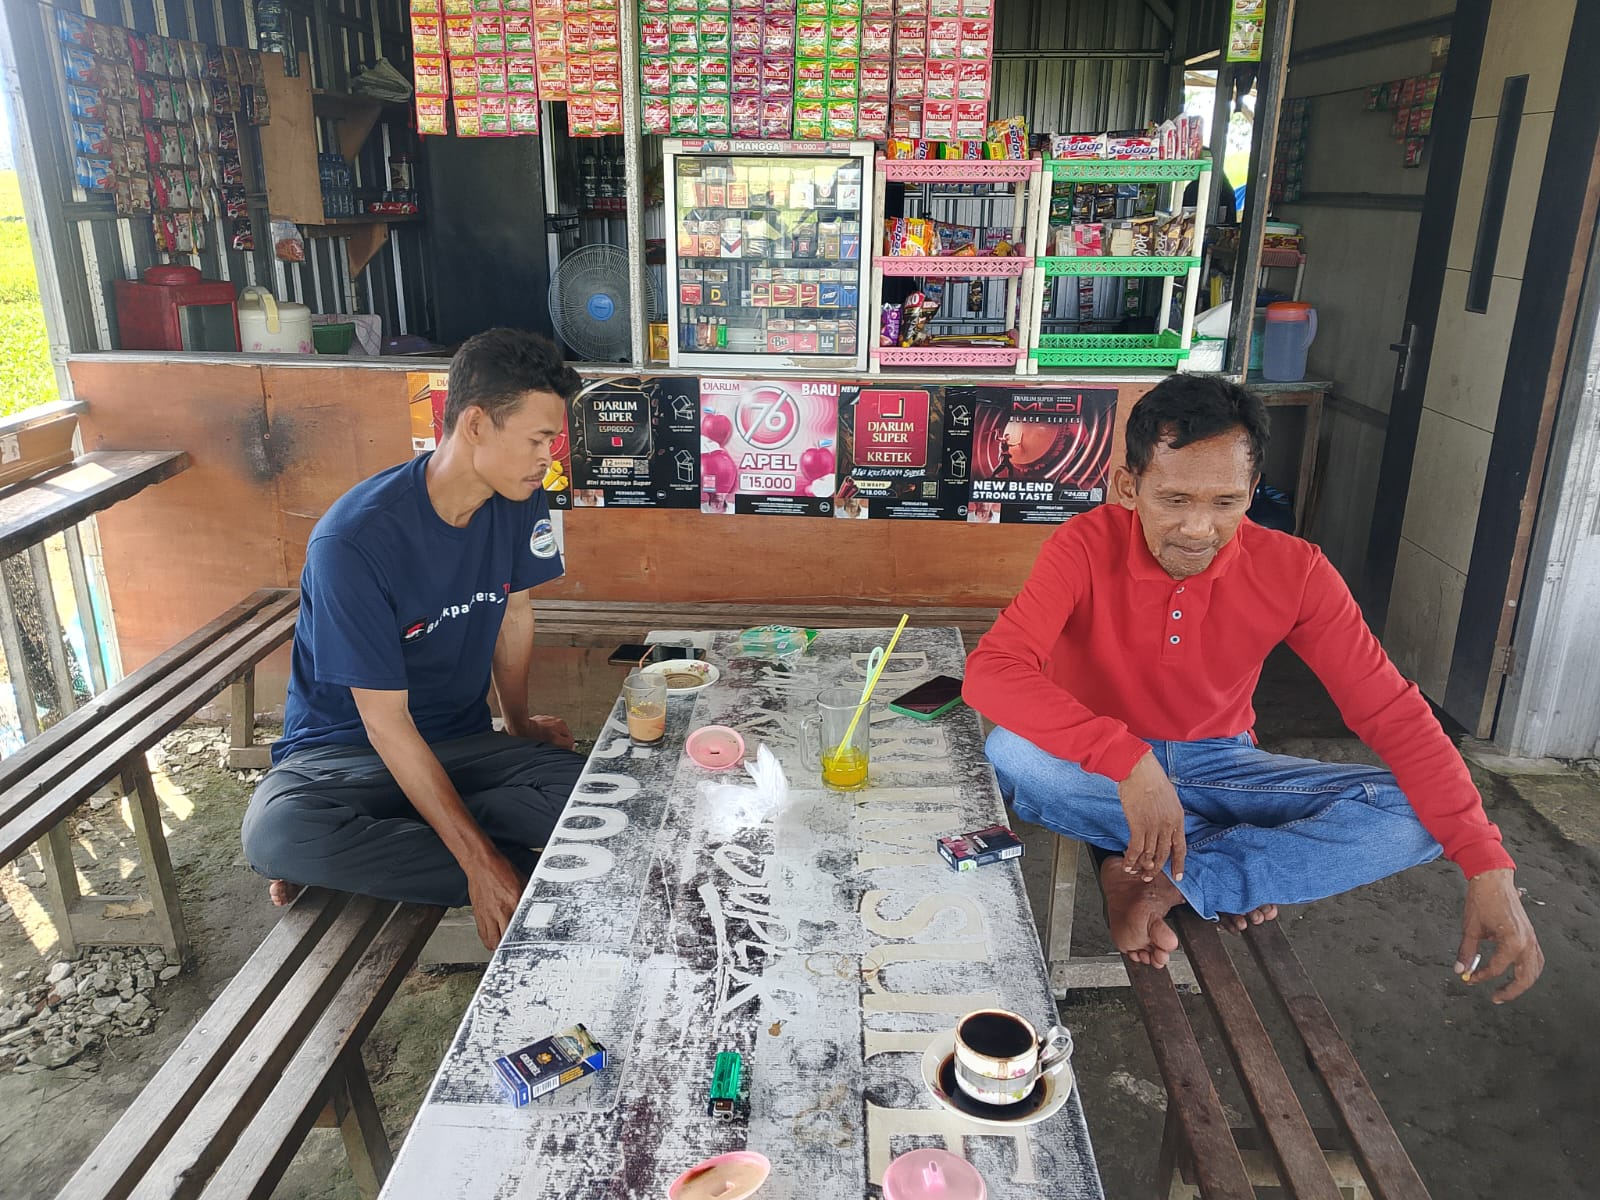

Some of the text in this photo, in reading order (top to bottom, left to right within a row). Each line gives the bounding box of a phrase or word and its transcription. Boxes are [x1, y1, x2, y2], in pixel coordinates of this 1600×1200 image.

[735, 142, 780, 151] MANGGA
[1008, 124, 1022, 160] Sedaa
[1055, 141, 1104, 152] Sedaap
[1108, 144, 1158, 154] Sedaap
[702, 382, 740, 391] DJARUM
[801, 383, 838, 396] BARU
[593, 400, 638, 411] DJARUM
[598, 412, 633, 422] SUPER
[868, 422, 914, 432] DJARUM
[872, 433, 908, 443] SUPER
[740, 453, 796, 470] APEL
[867, 452, 912, 462] KRETEK
[903, 469, 926, 478] SUPER
[749, 476, 792, 490] 15.000
[974, 481, 1005, 490] NEW
[1009, 482, 1054, 492] BLEND
[972, 491, 1053, 500] STRONG TASTE
